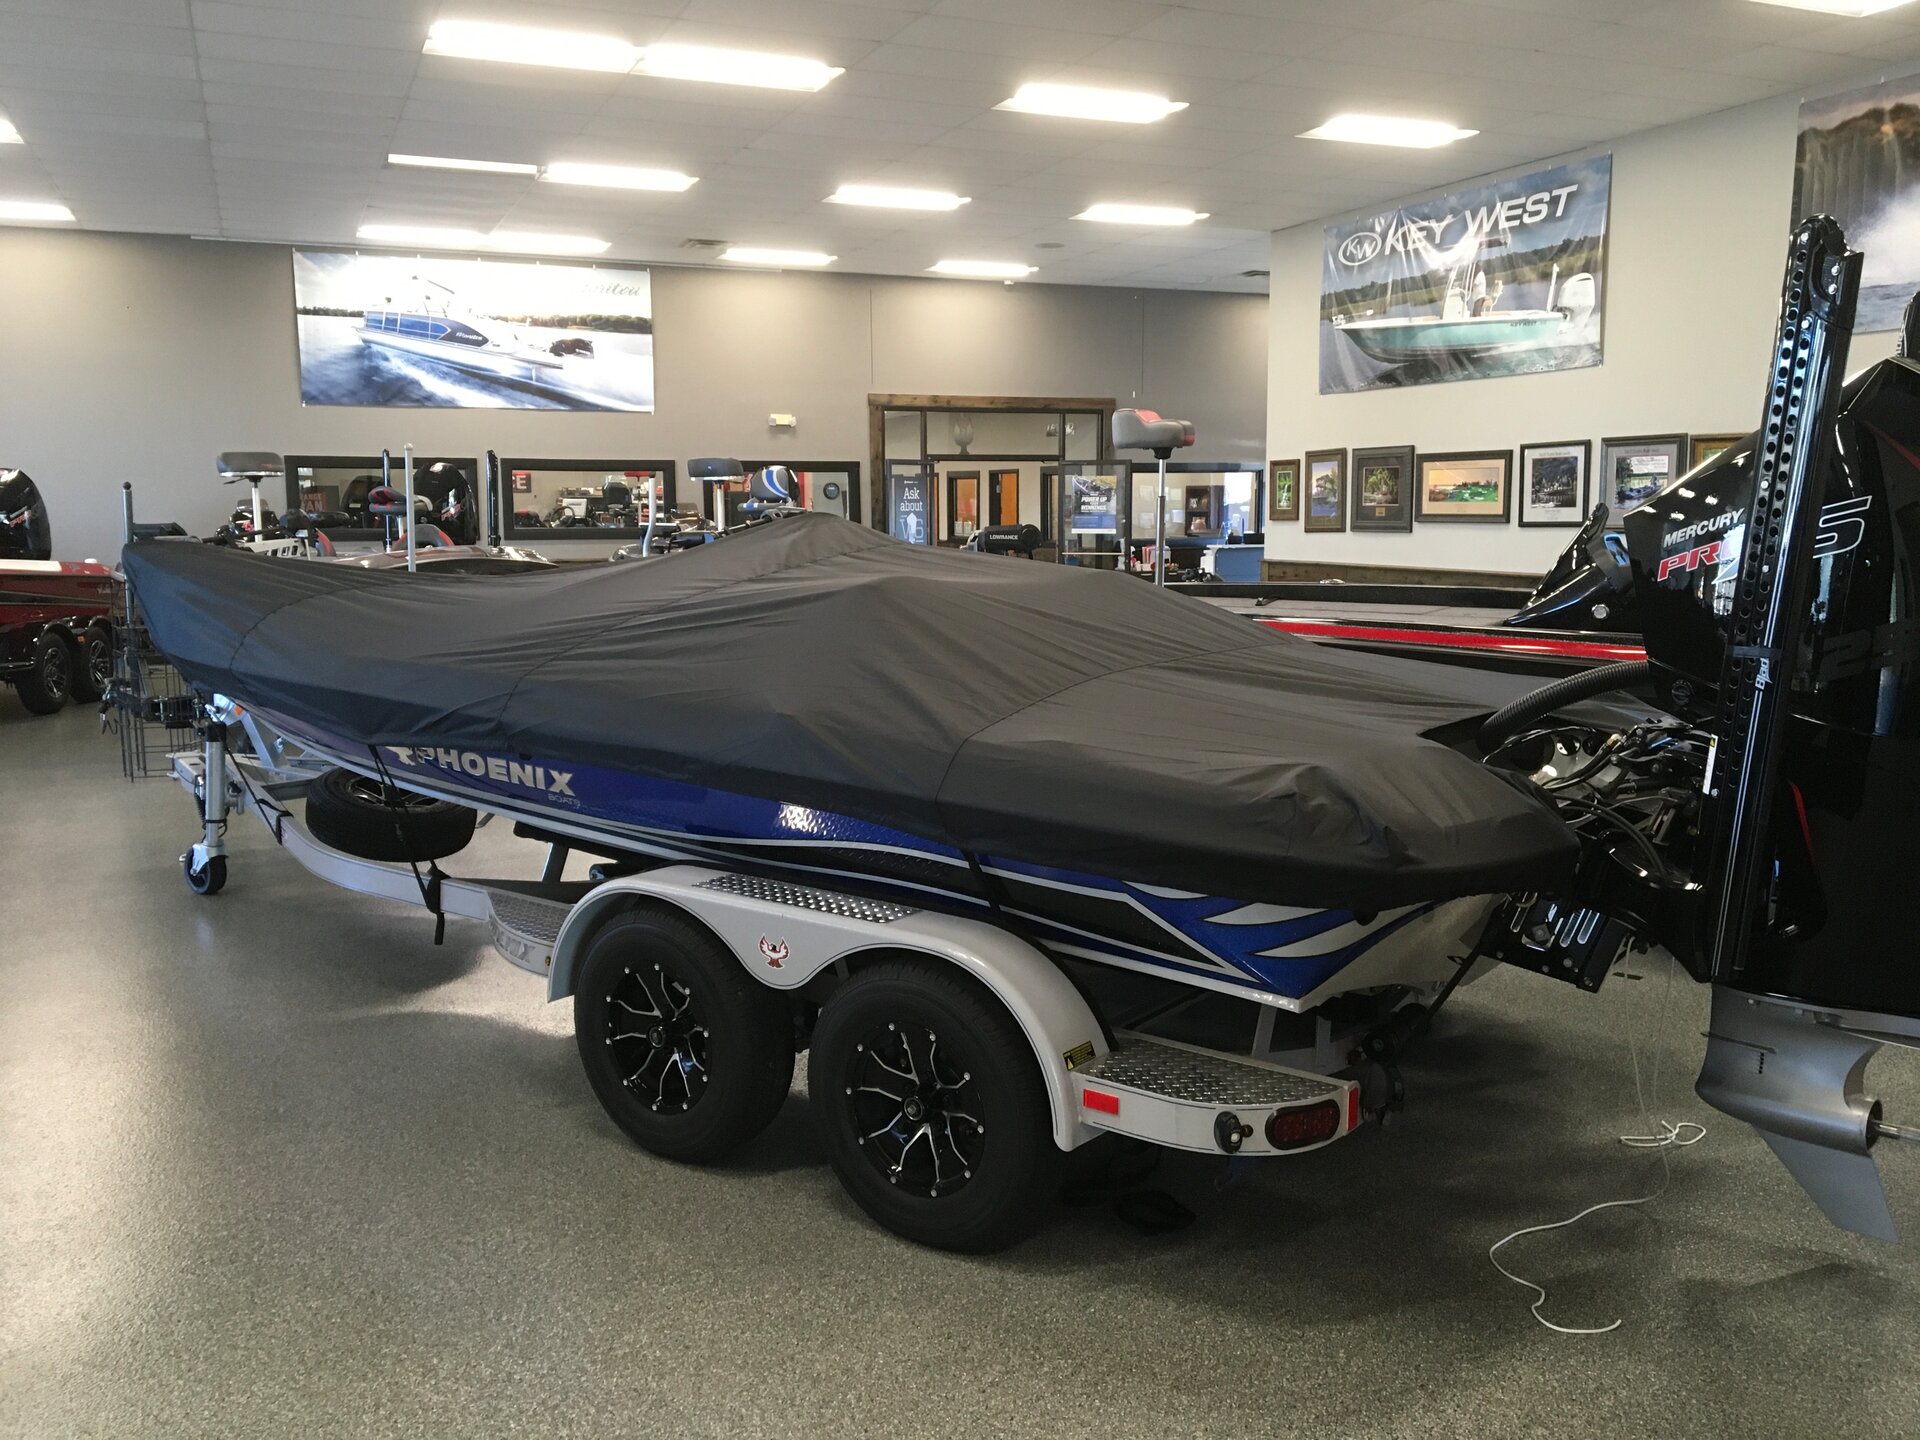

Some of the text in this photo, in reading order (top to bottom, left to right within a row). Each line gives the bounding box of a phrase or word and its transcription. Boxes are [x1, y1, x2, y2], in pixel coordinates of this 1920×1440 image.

[1385, 184, 1579, 256] KEY WEST
[900, 501, 923, 512] about
[903, 487, 920, 500] Ask
[1663, 507, 1746, 548] MERCURY
[414, 747, 576, 797] PHOENIX
